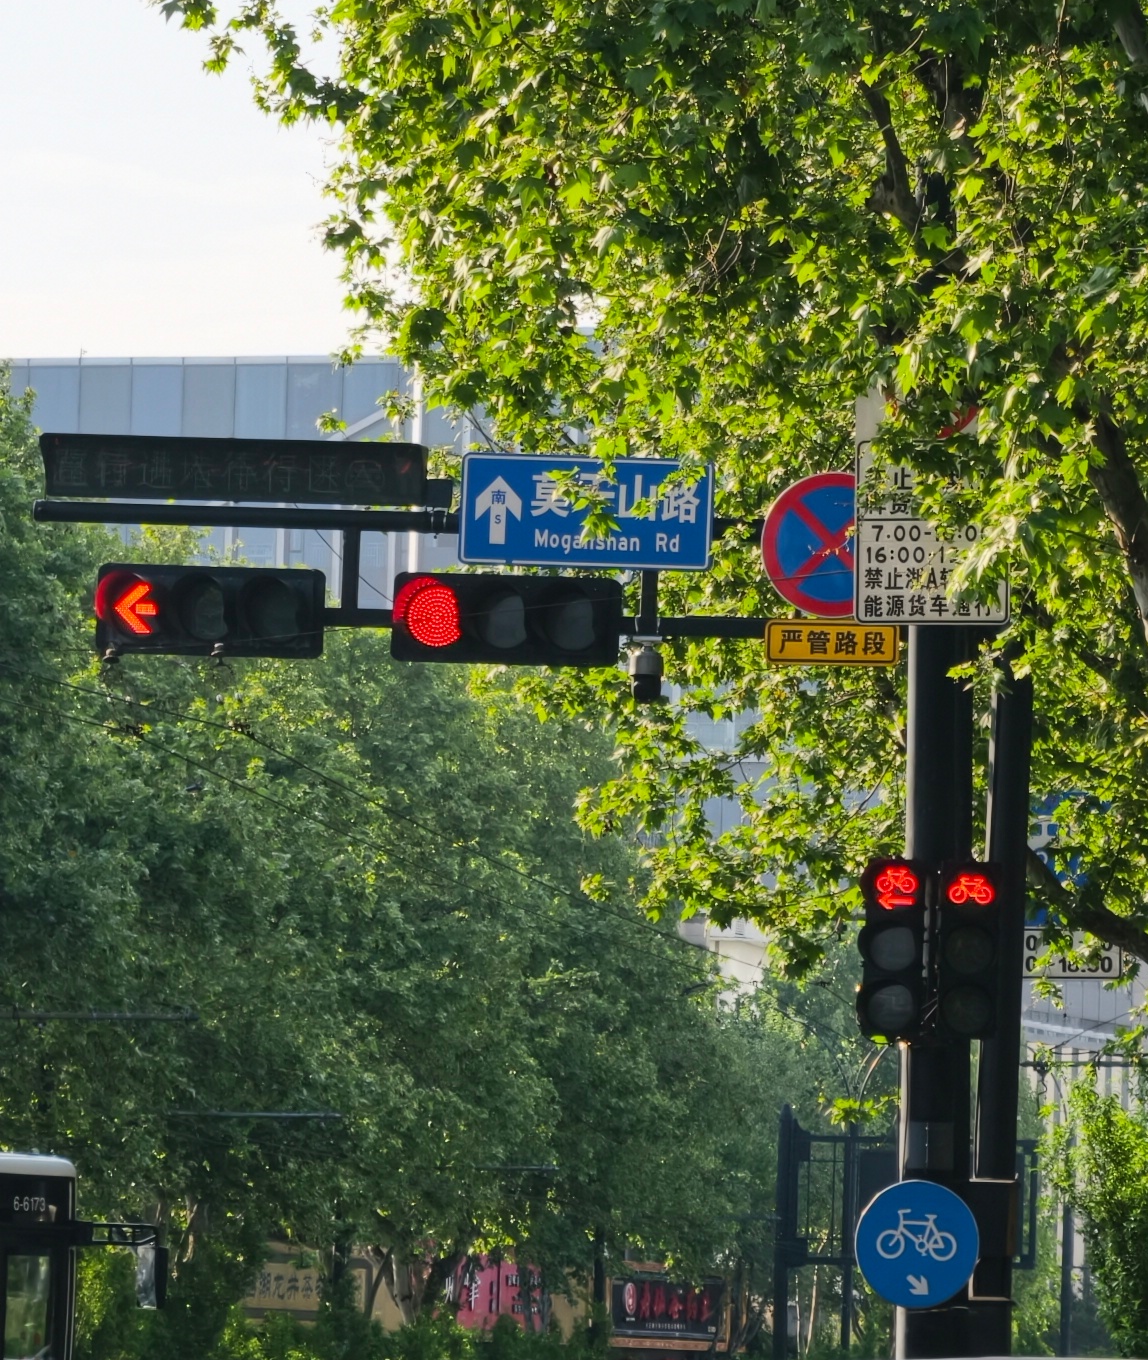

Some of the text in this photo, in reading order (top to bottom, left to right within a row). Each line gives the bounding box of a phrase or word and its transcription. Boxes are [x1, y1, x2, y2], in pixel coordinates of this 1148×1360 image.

[491, 490, 507, 505] 南
[494, 514, 502, 525] S
[655, 532, 680, 553] Rd
[778, 629, 886, 656] 严管路段
[14, 1196, 46, 1212] 6-6173
